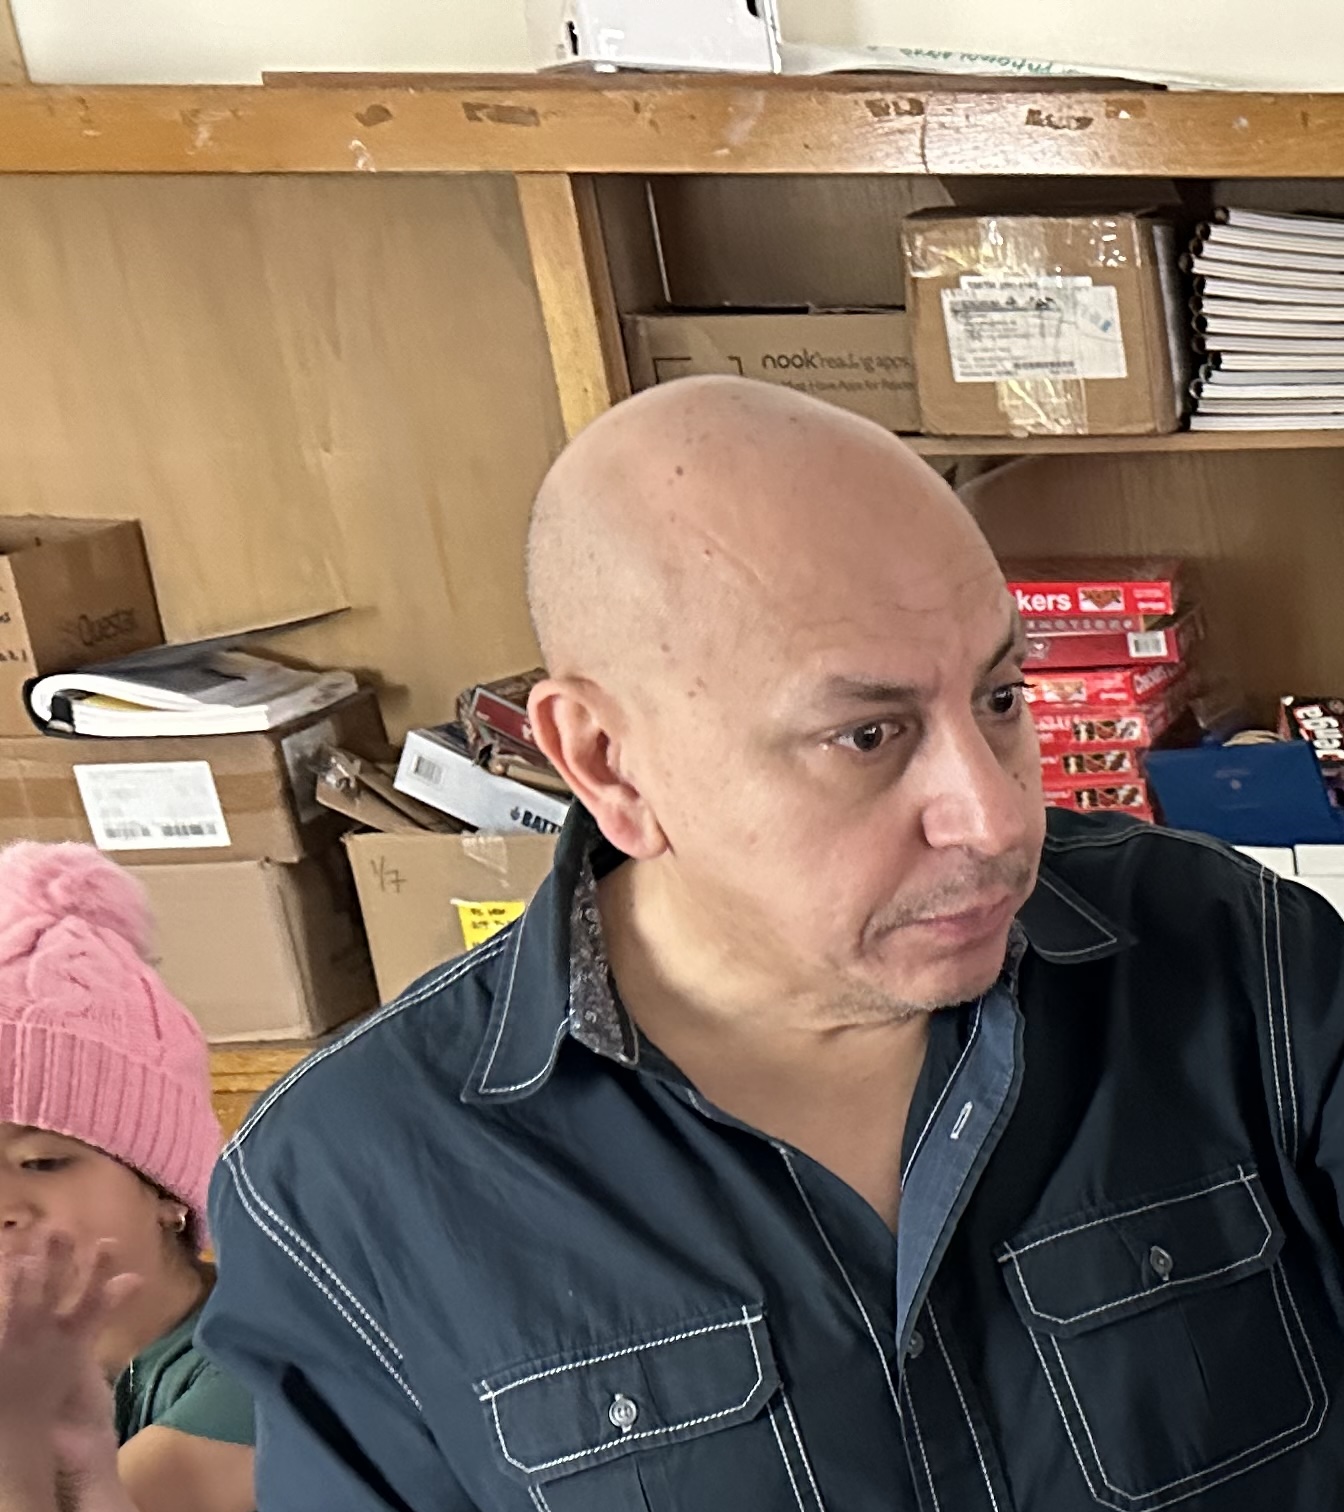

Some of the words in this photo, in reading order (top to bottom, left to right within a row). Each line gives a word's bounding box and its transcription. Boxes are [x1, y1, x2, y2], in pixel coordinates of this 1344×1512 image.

[762, 349, 818, 369] nook
[1015, 589, 1072, 612] kers
[522, 809, 562, 834] BATT
